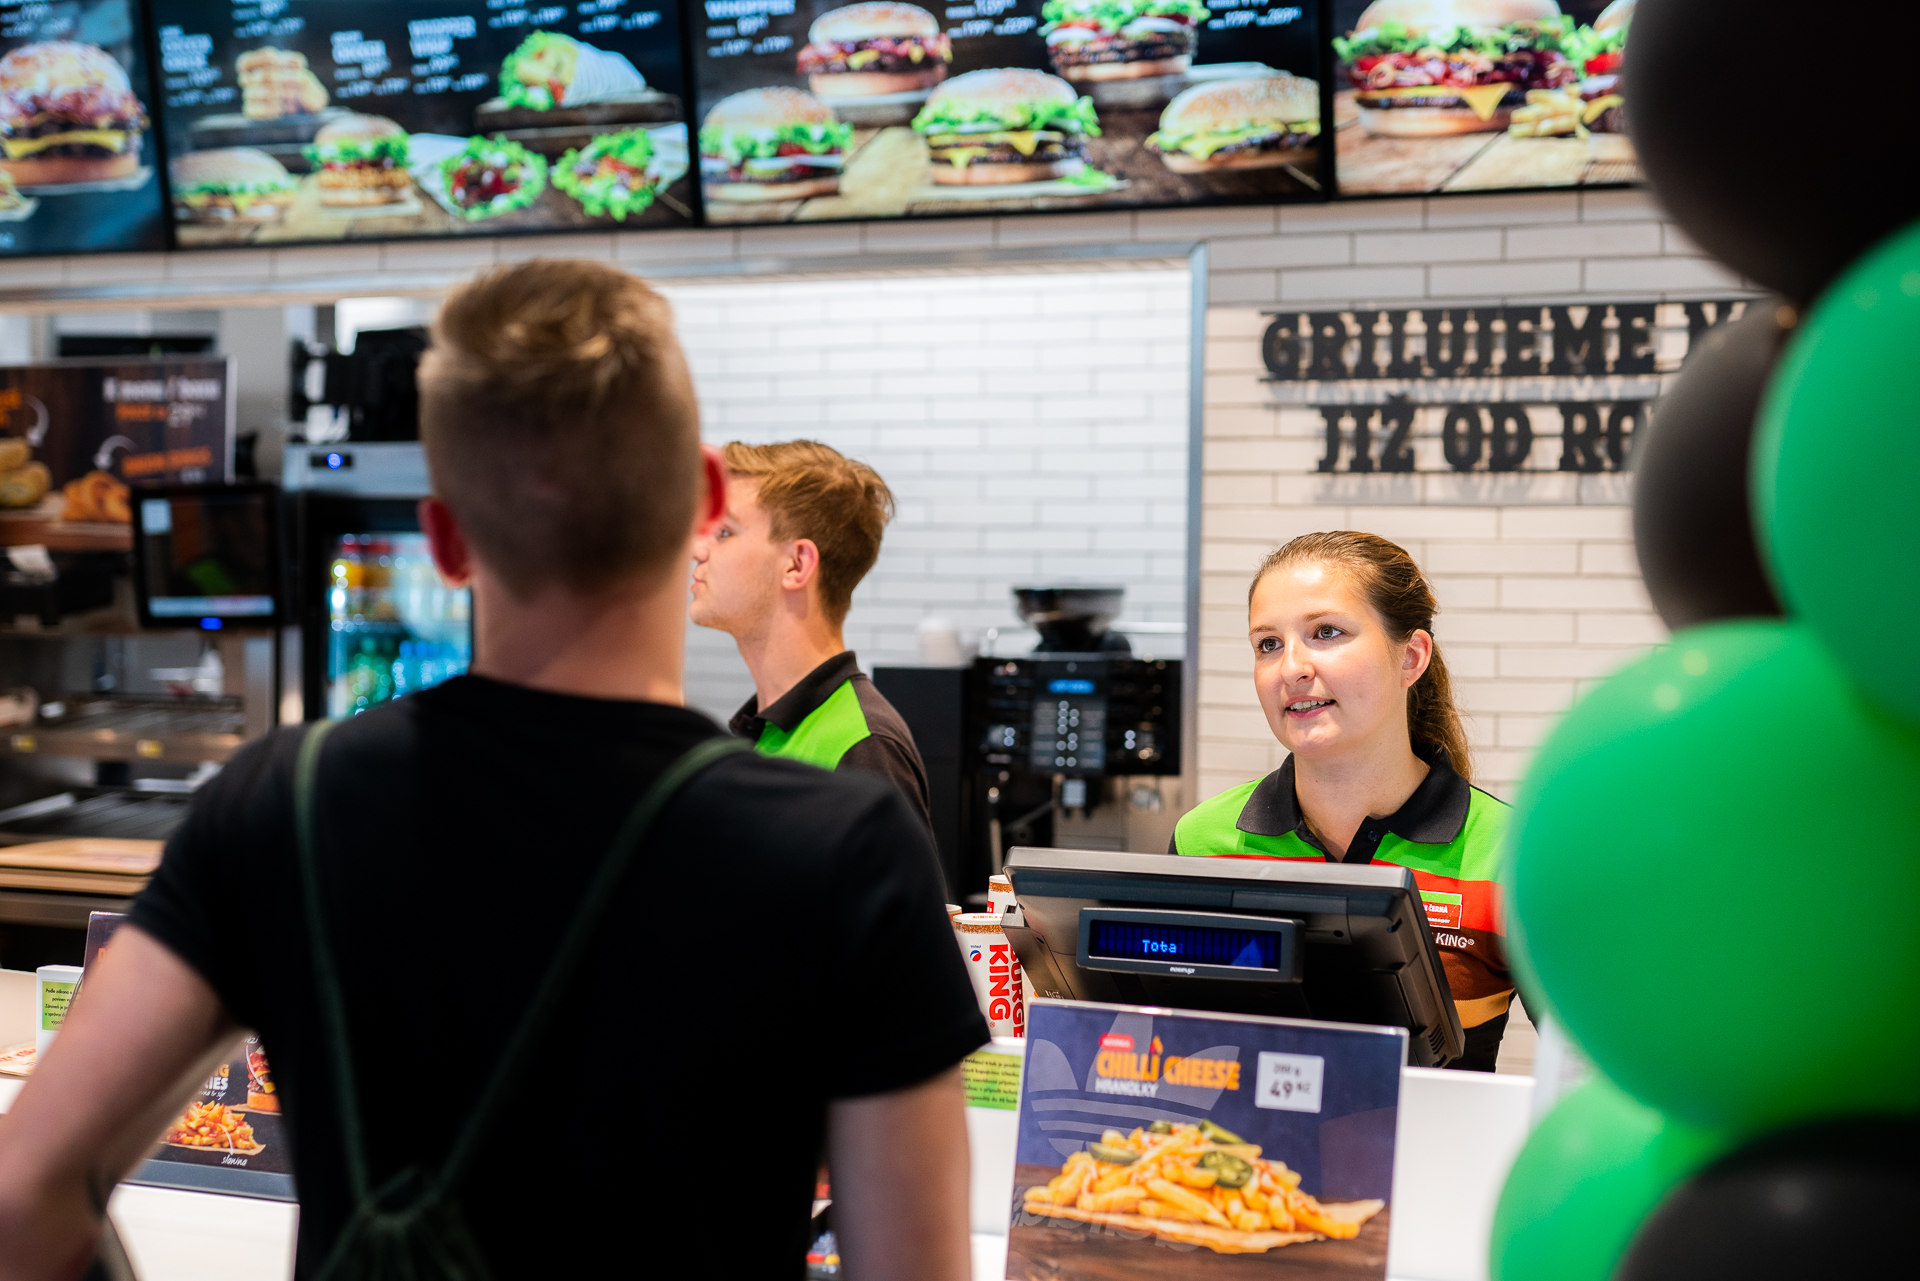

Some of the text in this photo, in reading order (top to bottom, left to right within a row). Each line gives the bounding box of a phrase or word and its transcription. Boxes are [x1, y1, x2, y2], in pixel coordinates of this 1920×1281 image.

[1261, 304, 1657, 379] GRILUJEME
[1317, 394, 1641, 472] JIŽ OD RO
[1163, 1055, 1242, 1091] CHEESE
[1269, 1080, 1293, 1099] 49
